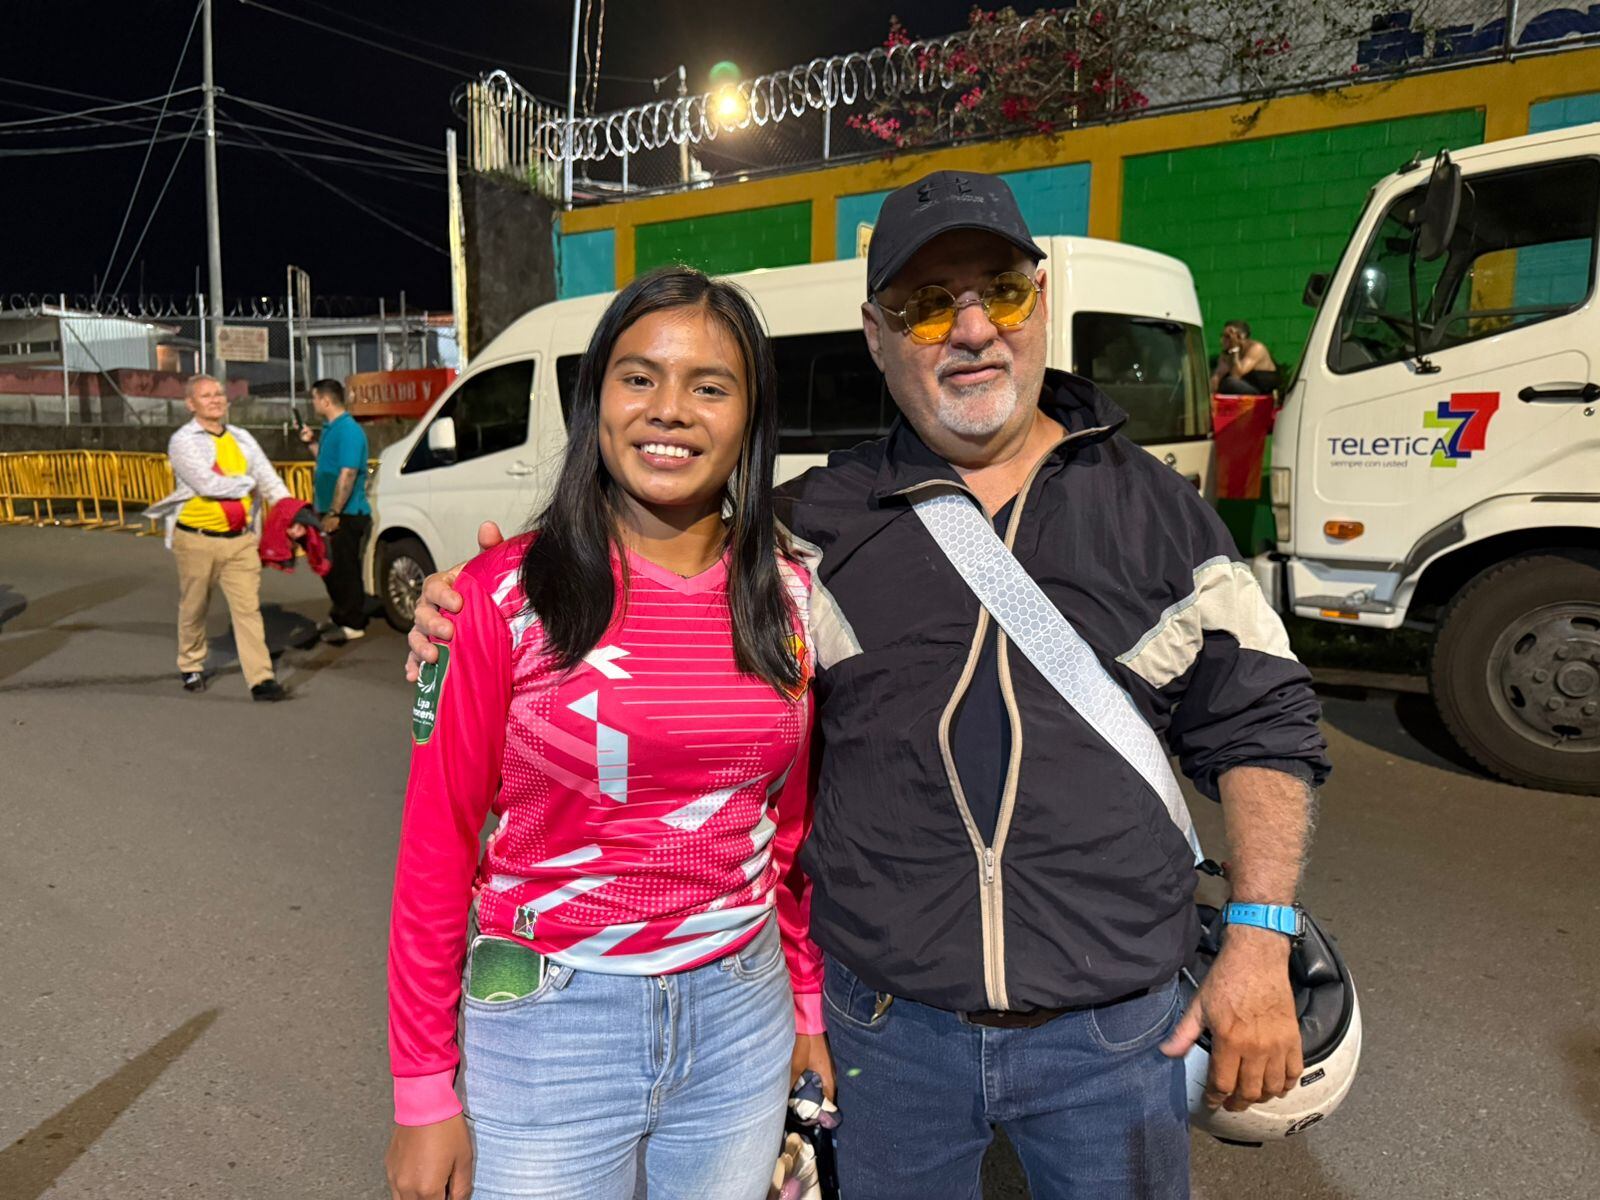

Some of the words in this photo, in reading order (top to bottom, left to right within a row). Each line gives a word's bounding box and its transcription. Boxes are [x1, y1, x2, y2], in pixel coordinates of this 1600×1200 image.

[1330, 460, 1363, 469] siempre
[1364, 460, 1381, 468] con
[1383, 460, 1408, 468] usted
